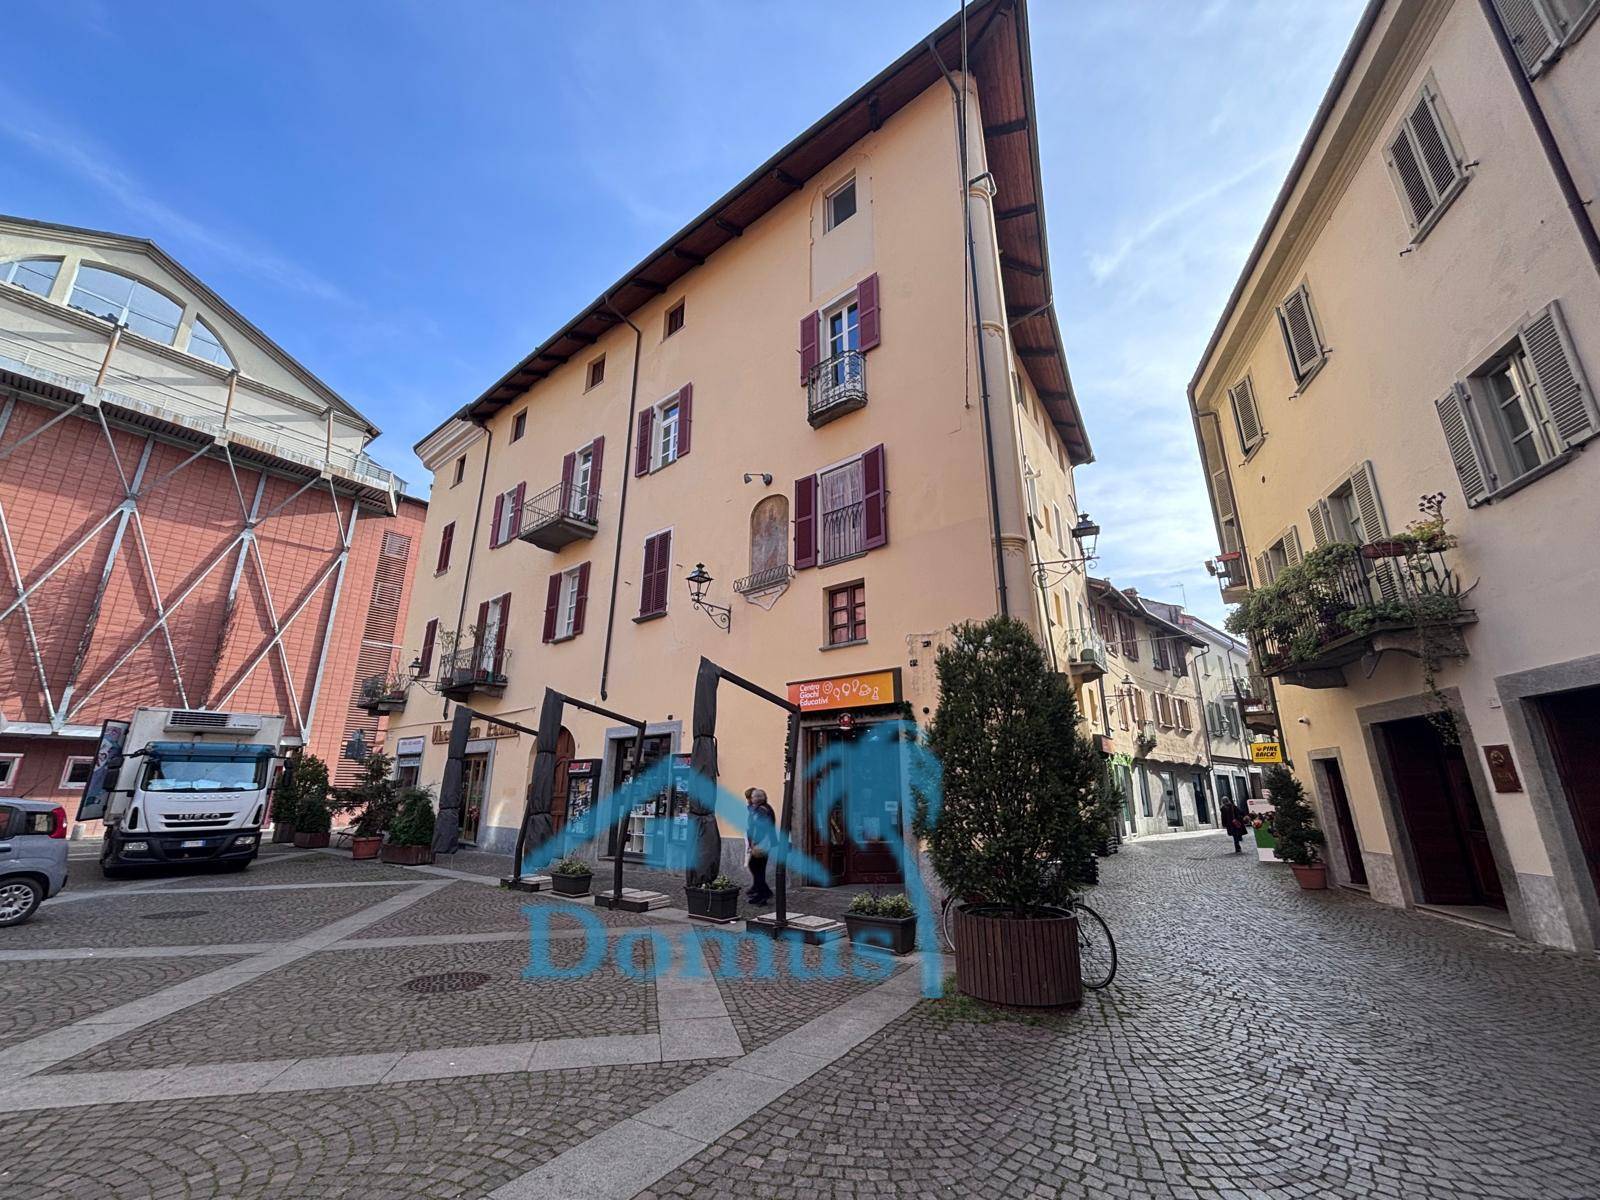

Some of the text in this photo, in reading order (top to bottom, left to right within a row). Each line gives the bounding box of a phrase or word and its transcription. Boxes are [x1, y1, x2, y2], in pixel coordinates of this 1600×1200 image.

[799, 690, 820, 699] Giochi
[799, 697, 828, 706] Educativi
[178, 813, 221, 821] IVECO
